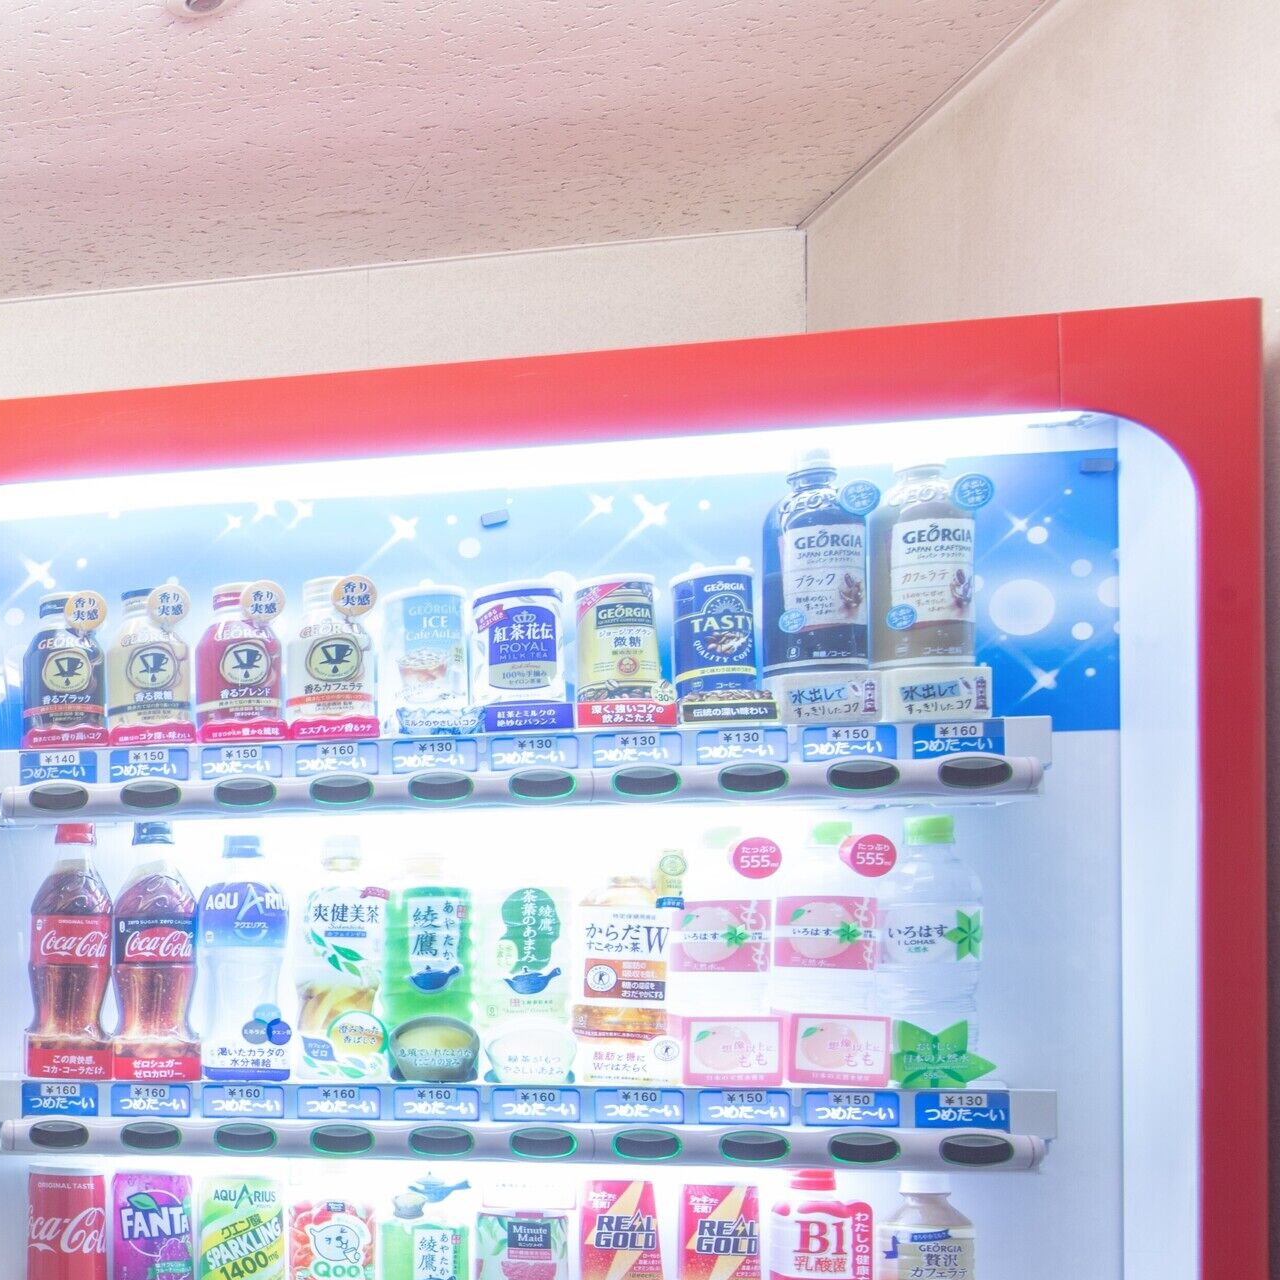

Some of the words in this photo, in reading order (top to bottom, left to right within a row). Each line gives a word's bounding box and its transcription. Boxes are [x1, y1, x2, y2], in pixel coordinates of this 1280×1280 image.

[794, 529, 863, 550] GEORGIA
[902, 524, 972, 545] GEORGIA
[794, 572, 837, 588] ブラック
[901, 568, 950, 585] カフェラテ
[703, 580, 745, 593] GEORGIA
[74, 597, 97, 609] 香り
[73, 608, 99, 621] 実感
[421, 614, 449, 628] ICE
[690, 614, 754, 633] TASTY
[492, 621, 555, 643] 紅茶花伝
[499, 640, 548, 654] ROYAL
[613, 636, 642, 649] 微糖
[791, 687, 845, 703] 水出しで
[496, 709, 556, 720] 紅茶とミルクの
[692, 706, 769, 718] 伝統の深い味わい
[793, 702, 860, 719] すっきりしたコク
[602, 711, 655, 725] 飲みごたえ
[723, 731, 760, 743] ¥130
[832, 728, 869, 739] ¥150
[321, 745, 354, 756] ¥160
[418, 742, 452, 753] ¥130
[44, 754, 76, 764] ¥140
[132, 750, 165, 761] ¥150
[741, 845, 776, 854] たっぷり
[312, 903, 380, 924] 爽健美茶
[411, 906, 439, 957] 綾鷹
[443, 900, 454, 962] あやたか
[523, 889, 538, 964] 茶葉のあまみ
[888, 924, 949, 940] いろはす
[40, 930, 109, 959] Coca-Cola
[125, 930, 192, 959] Coca-Cola
[217, 1047, 285, 1058] 渇いたカラダの
[132, 1058, 183, 1069] ゼロシュガー
[230, 1057, 272, 1068] 水分補給
[132, 1069, 186, 1080] ゼロカロリー。
[134, 1088, 166, 1098] ¥160
[322, 1089, 356, 1100] ¥160
[622, 1092, 657, 1102] ¥160
[38, 1182, 71, 1190] ORIGINAL
[73, 1182, 96, 1191] TASTE
[213, 1184, 276, 1209] AQUARIUS
[121, 1206, 189, 1239] FANTA
[220, 1213, 262, 1238] クエン酸
[596, 1214, 655, 1233] REAL
[512, 1224, 548, 1236] Minute
[207, 1219, 281, 1270] SPARKLING
[518, 1233, 544, 1243] Maid
[594, 1231, 658, 1250] GOLD
[793, 1220, 848, 1255] B1
[418, 1236, 437, 1273] 綾鷹
[918, 1244, 962, 1254] GEORGIA
[794, 1256, 847, 1273] 乳酸菌
[923, 1252, 959, 1267] 贅沢
[313, 1260, 361, 1279] Qoo
[911, 1267, 968, 1279] カフェラテ
